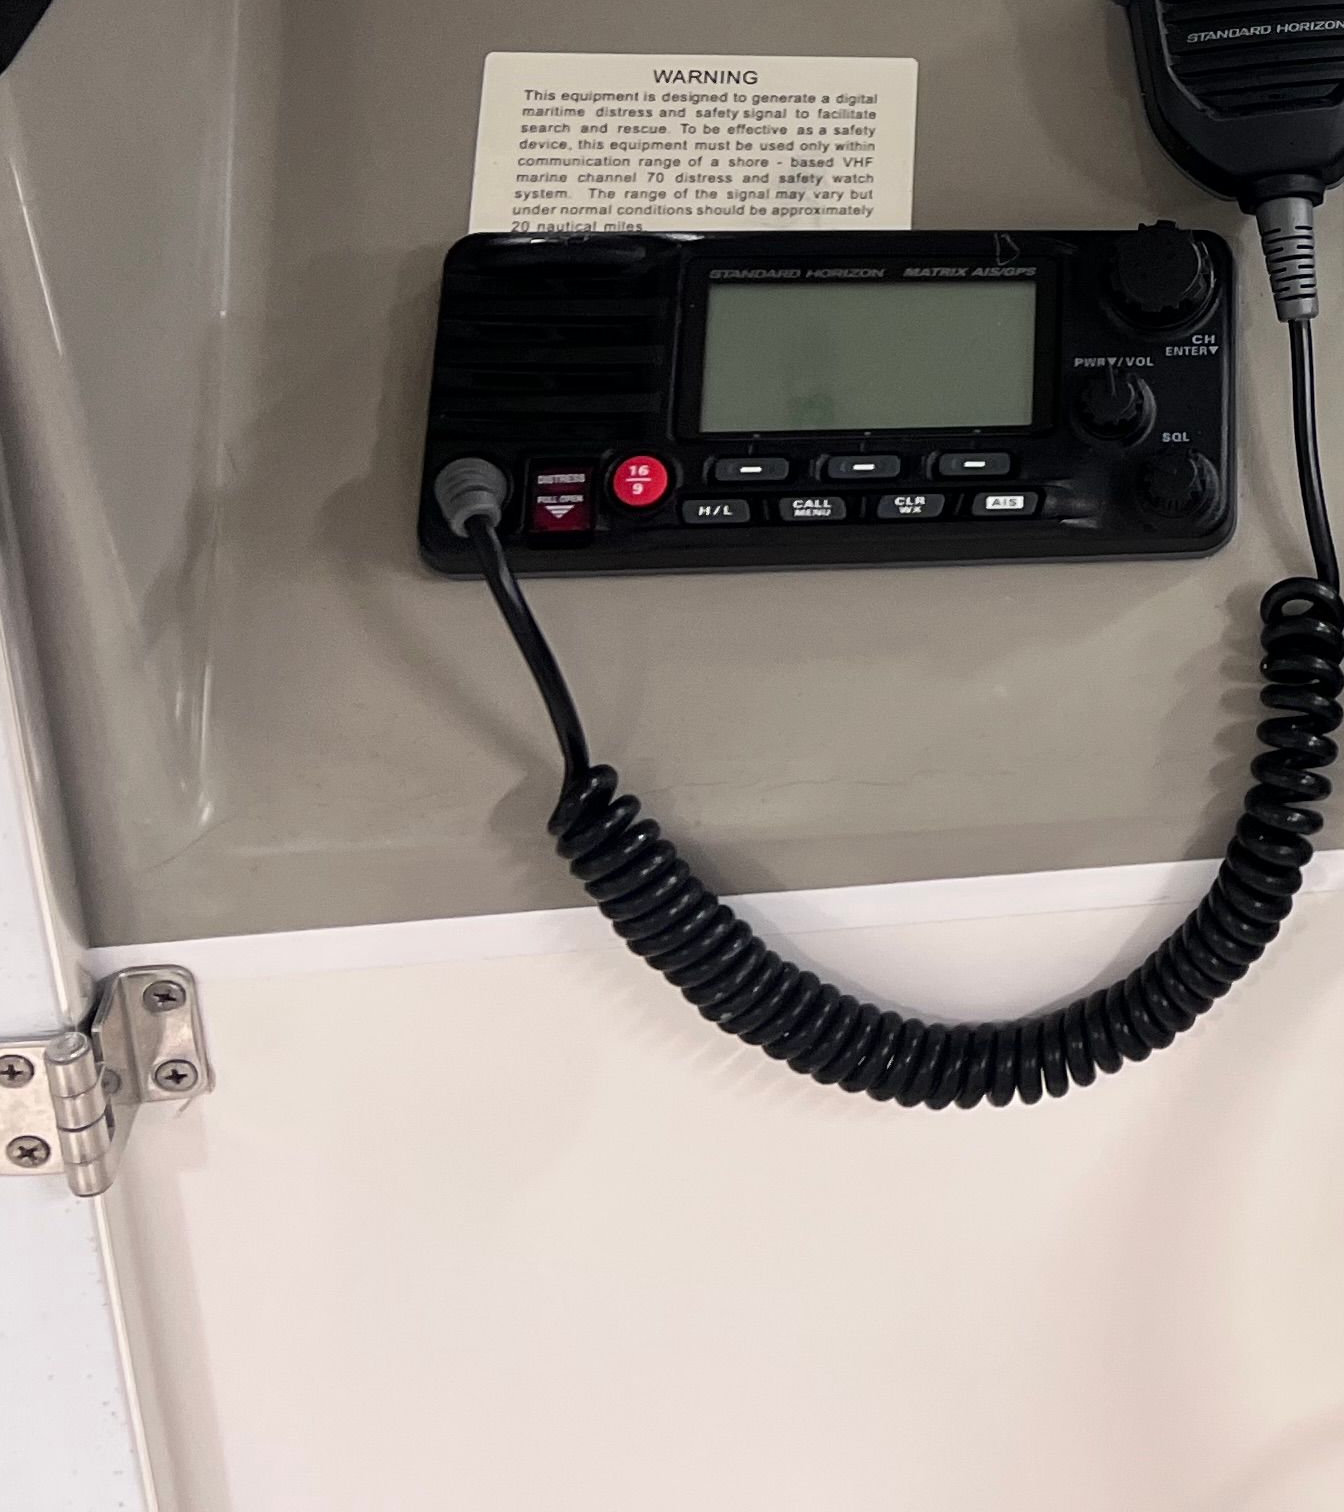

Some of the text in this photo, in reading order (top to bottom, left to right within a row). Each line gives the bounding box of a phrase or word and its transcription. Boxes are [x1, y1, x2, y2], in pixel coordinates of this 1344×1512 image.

[1186, 23, 1272, 44] STANDARD
[653, 69, 759, 85] WARNING
[524, 89, 878, 107] This equipment is designed to generate digital
[522, 106, 877, 121] maritime distress and safety signal to facilitate
[520, 123, 876, 138] search and To be effective as safety
[578, 139, 876, 153] this equipment must be used only within
[517, 155, 873, 169] communication range of shore based VHF
[516, 172, 874, 186] marine channel 70 distress and safety watch
[587, 187, 873, 202] The range of the signal may vary but
[512, 204, 874, 218] under normal conditions should be approximately
[511, 221, 597, 232] 20 nautical
[708, 269, 801, 280] STANDARD
[805, 268, 886, 279] HORIZON
[903, 266, 968, 278] MATRIX
[1191, 334, 1216, 344] CH
[1165, 346, 1208, 357] ENTER
[1161, 432, 1190, 443] SQL
[629, 464, 650, 477] 16
[631, 483, 644, 495] 9
[792, 498, 832, 509] CALL
[894, 495, 926, 506] CLR
[697, 505, 734, 516] H/L
[897, 505, 923, 515] WX
